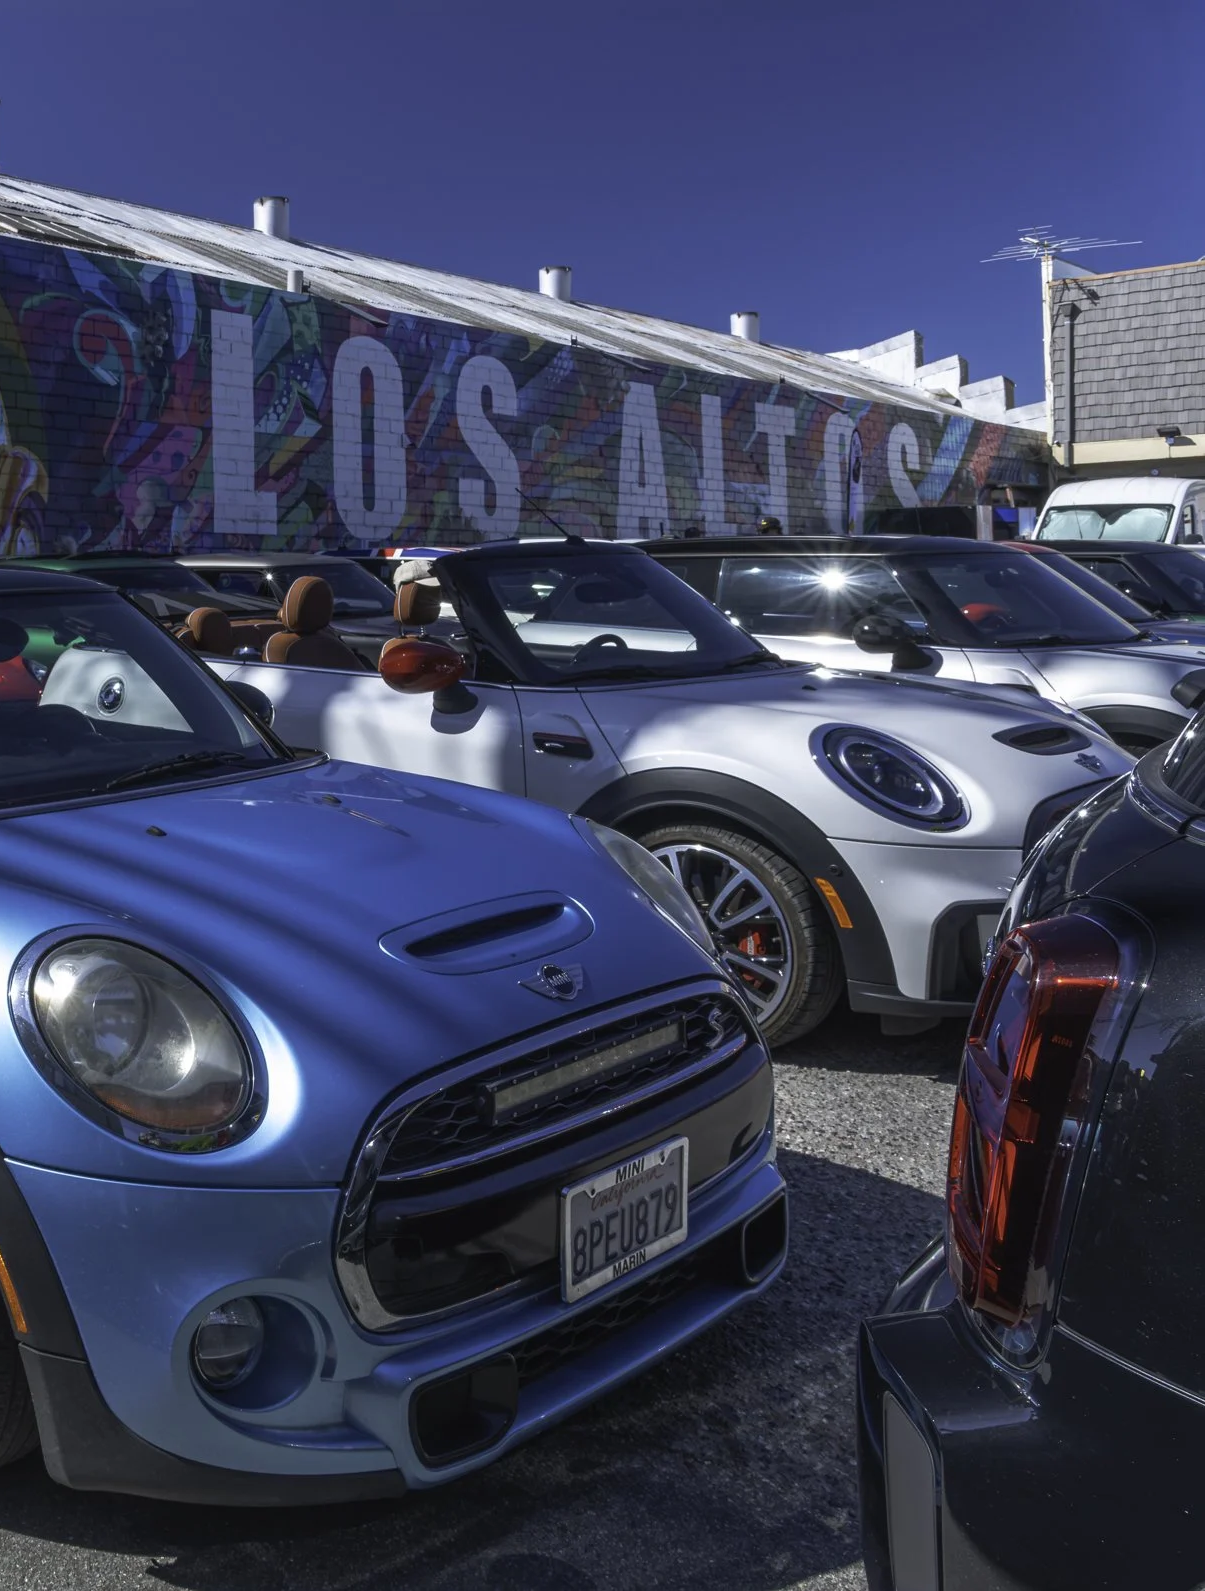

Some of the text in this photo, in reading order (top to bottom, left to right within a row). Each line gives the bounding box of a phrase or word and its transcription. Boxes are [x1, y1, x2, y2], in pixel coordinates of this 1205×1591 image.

[210, 308, 922, 541] LOS ALTOS
[546, 971, 572, 987] MINI
[615, 1156, 645, 1184] MINI
[590, 1168, 664, 1212] California
[572, 1182, 679, 1277] 8PEU879
[612, 1248, 647, 1279] MARIN
